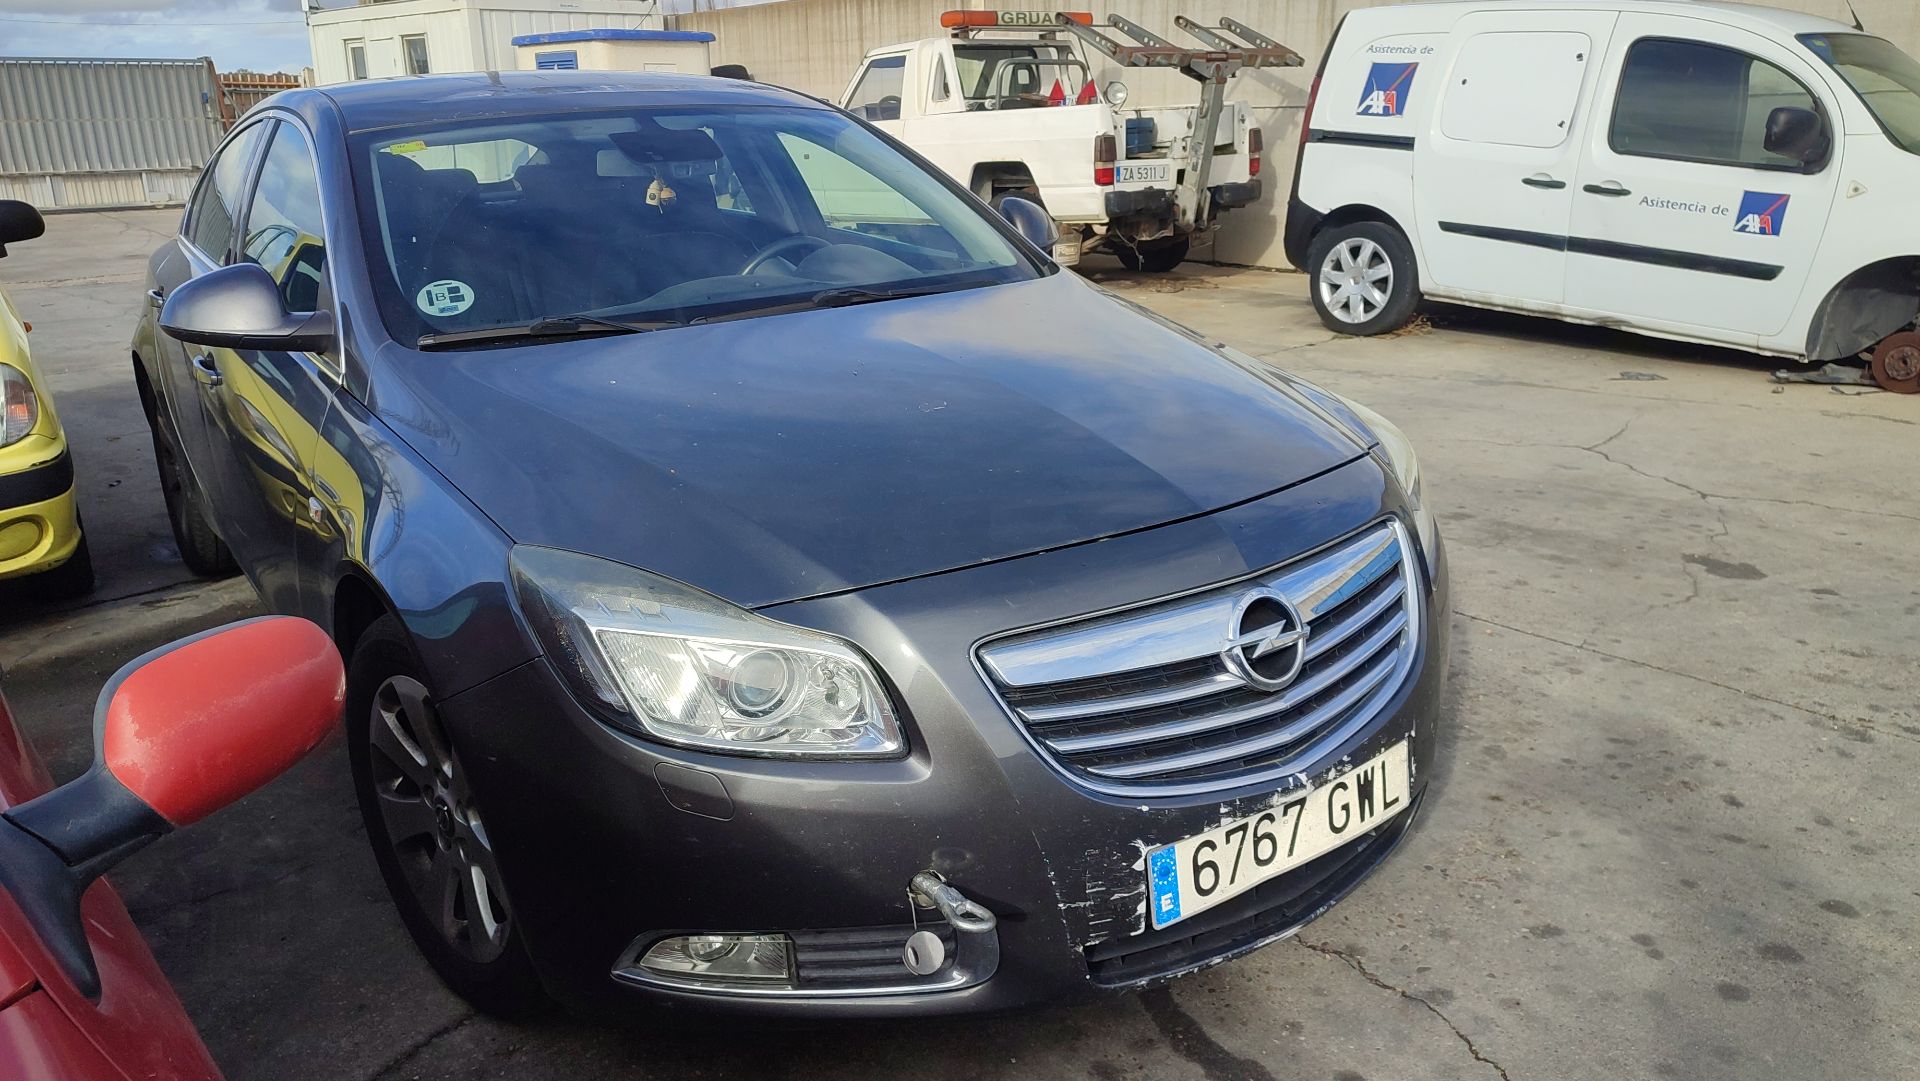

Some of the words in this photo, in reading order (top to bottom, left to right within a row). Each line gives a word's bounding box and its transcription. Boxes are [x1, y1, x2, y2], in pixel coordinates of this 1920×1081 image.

[1001, 12, 1053, 24] GRUA
[1367, 44, 1417, 54] Asistencia
[1420, 46, 1434, 54] de
[1357, 90, 1397, 114] AXA
[1123, 168, 1134, 180] ZA
[1137, 167, 1156, 180] 5311
[1639, 196, 1706, 213] Asistencia
[1711, 204, 1729, 216] de
[1734, 213, 1772, 235] AXA
[436, 293, 447, 301] B
[1192, 797, 1307, 897] 6767
[1328, 760, 1400, 834] GWL
[1161, 892, 1174, 912] E
